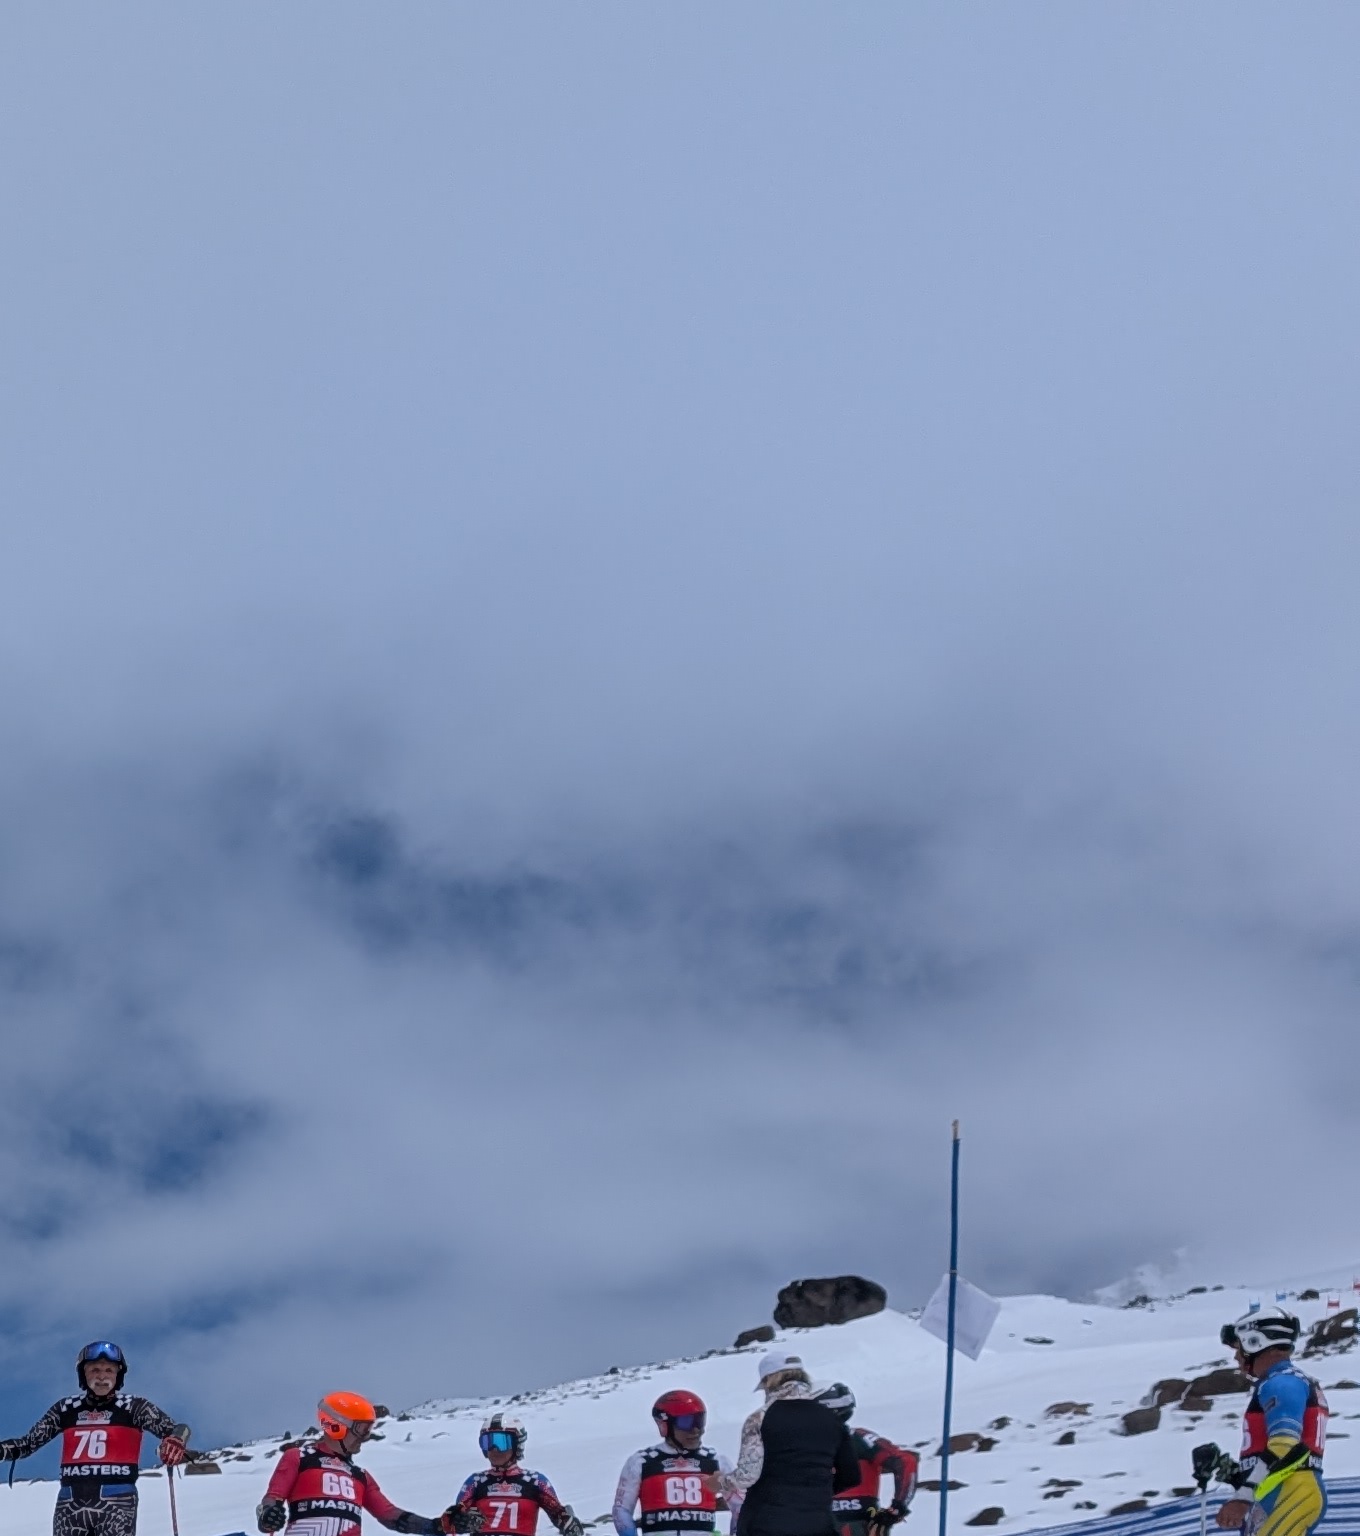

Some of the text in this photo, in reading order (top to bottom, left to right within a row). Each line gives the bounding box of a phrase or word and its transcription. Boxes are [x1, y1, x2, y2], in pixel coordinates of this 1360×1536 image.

[72, 1429, 108, 1460] 76
[62, 1464, 131, 1477] MASTERS
[322, 1472, 356, 1500] 66
[665, 1476, 703, 1505] 68
[489, 1501, 519, 1529] 71
